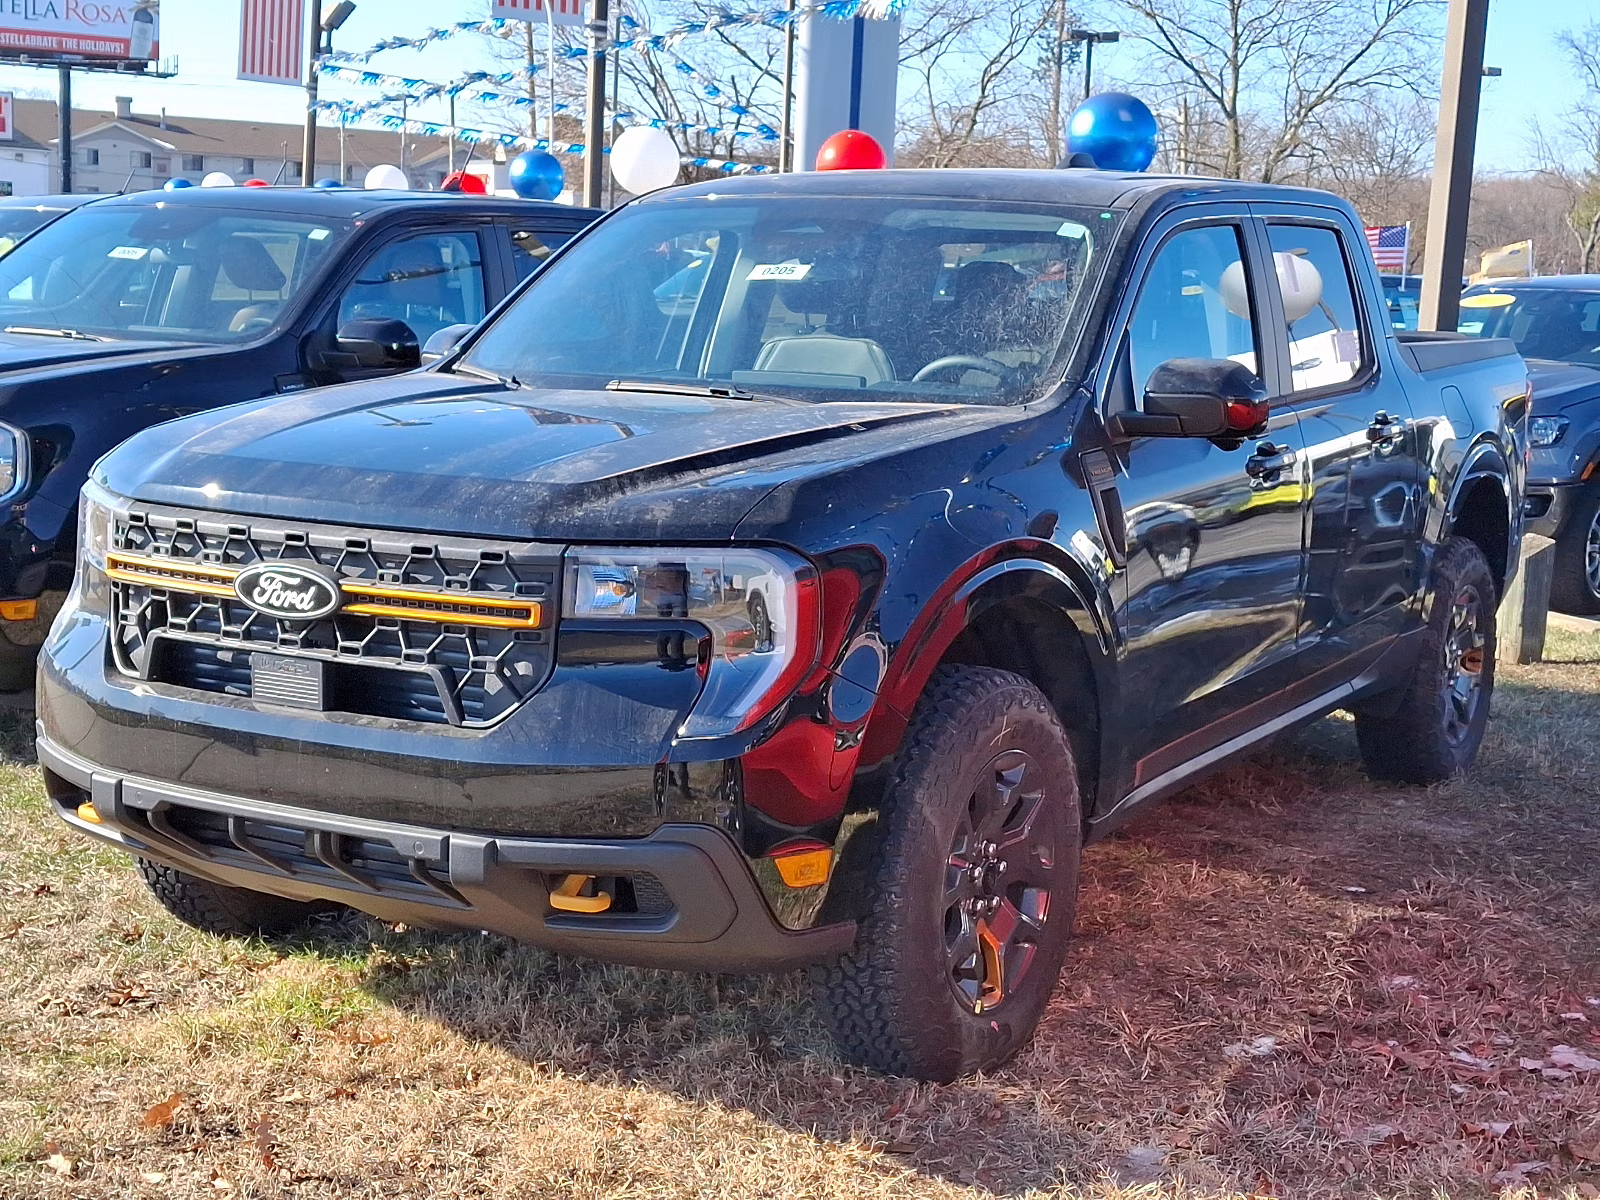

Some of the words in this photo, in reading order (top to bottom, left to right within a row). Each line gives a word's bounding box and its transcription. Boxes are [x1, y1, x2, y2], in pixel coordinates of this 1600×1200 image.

[65, 0, 127, 26] ROSA
[0, 32, 58, 48] STELLABRATE
[62, 37, 79, 50] THE
[79, 40, 125, 54] HOLIDAYS!
[761, 266, 797, 276] 0205
[253, 572, 317, 611] Ford
